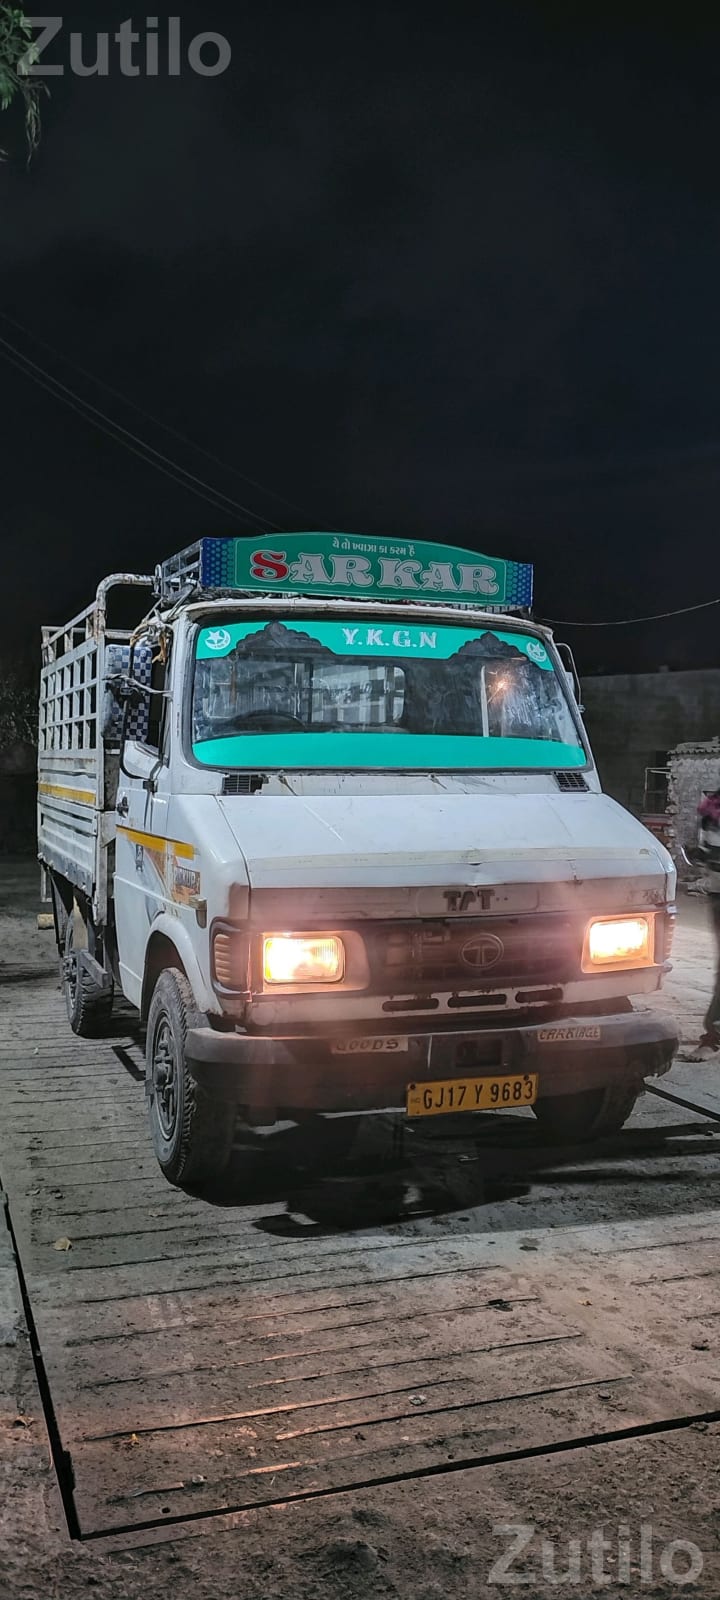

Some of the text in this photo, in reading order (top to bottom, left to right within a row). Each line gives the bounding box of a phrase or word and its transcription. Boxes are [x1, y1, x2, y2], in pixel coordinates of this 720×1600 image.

[341, 538, 351, 550] તો
[378, 545, 388, 554] કા
[389, 546, 406, 556] કરમ
[249, 549, 500, 596] SARKAR
[341, 628, 438, 649] Y.K.G.N
[422, 1080, 533, 1110] GJ17 Y 9683
